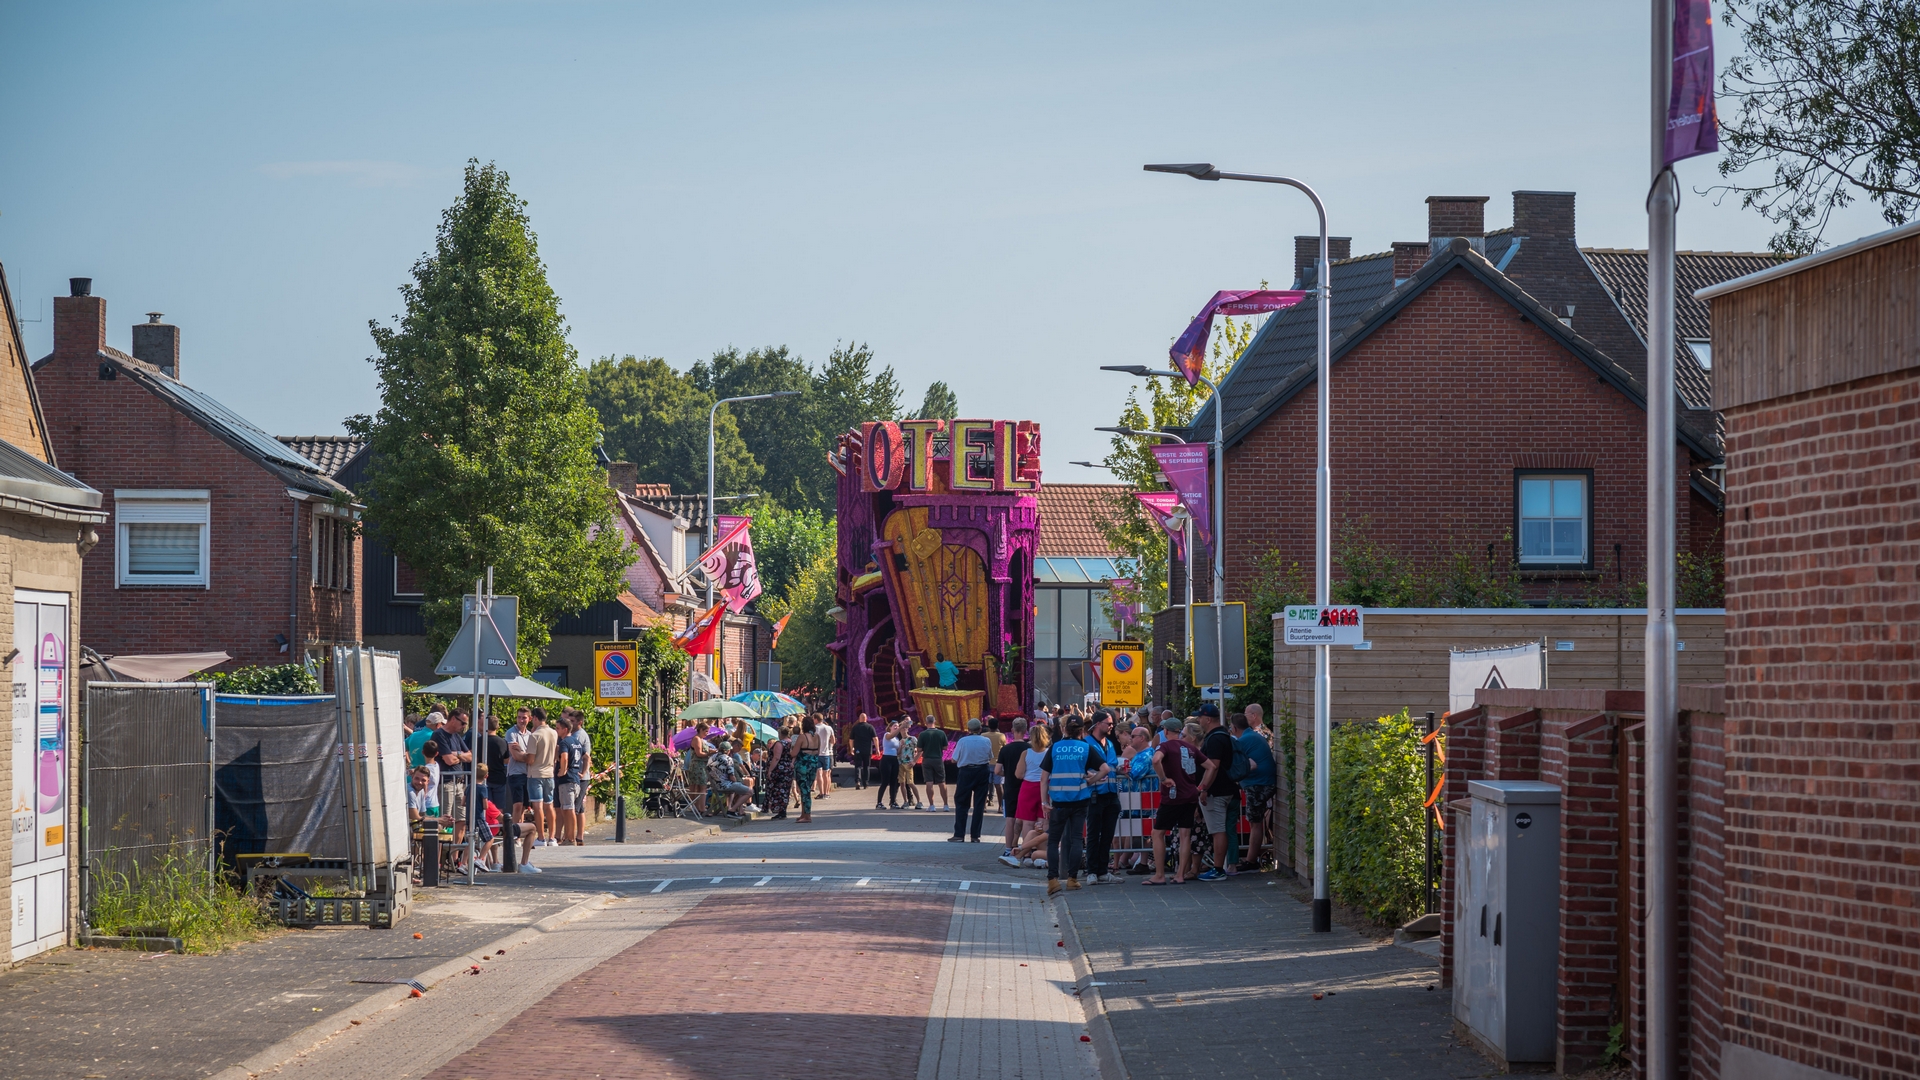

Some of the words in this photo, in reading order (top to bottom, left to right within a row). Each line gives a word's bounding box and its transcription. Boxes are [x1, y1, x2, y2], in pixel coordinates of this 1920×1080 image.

[1298, 609, 1318, 620] ACTIEF
[1660, 608, 1666, 617] 2
[1289, 633, 1333, 641] Buurtpreventie
[1056, 745, 1084, 753] corso
